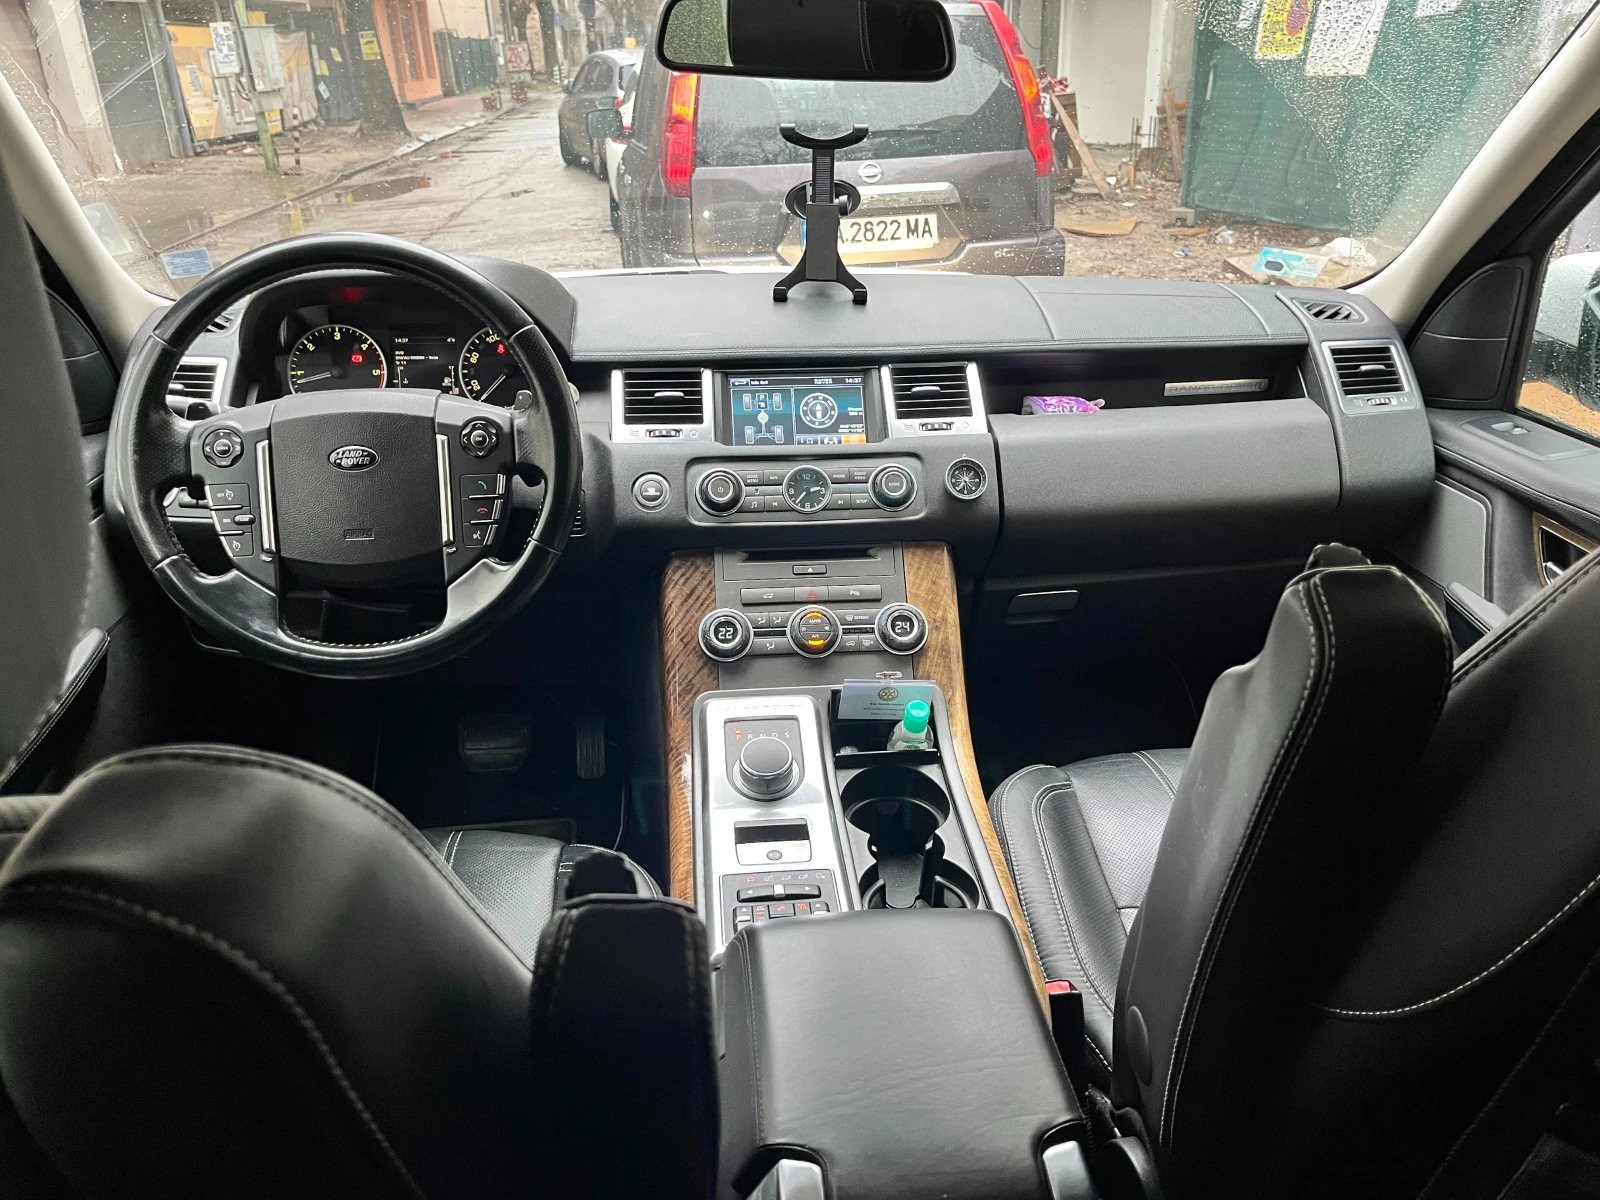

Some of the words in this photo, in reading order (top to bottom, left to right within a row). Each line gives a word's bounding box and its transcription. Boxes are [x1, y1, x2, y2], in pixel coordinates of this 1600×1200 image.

[905, 217, 933, 240] MA
[333, 331, 341, 340] 3
[306, 342, 316, 352] 2
[360, 343, 369, 351] 4
[469, 351, 480, 364] 60
[371, 368, 381, 376] 5
[470, 379, 481, 391] 20
[338, 450, 363, 458] LAND
[341, 457, 371, 465] ROVER
[788, 487, 795, 495] 9
[895, 621, 910, 633] 24
[718, 627, 733, 639] 22
